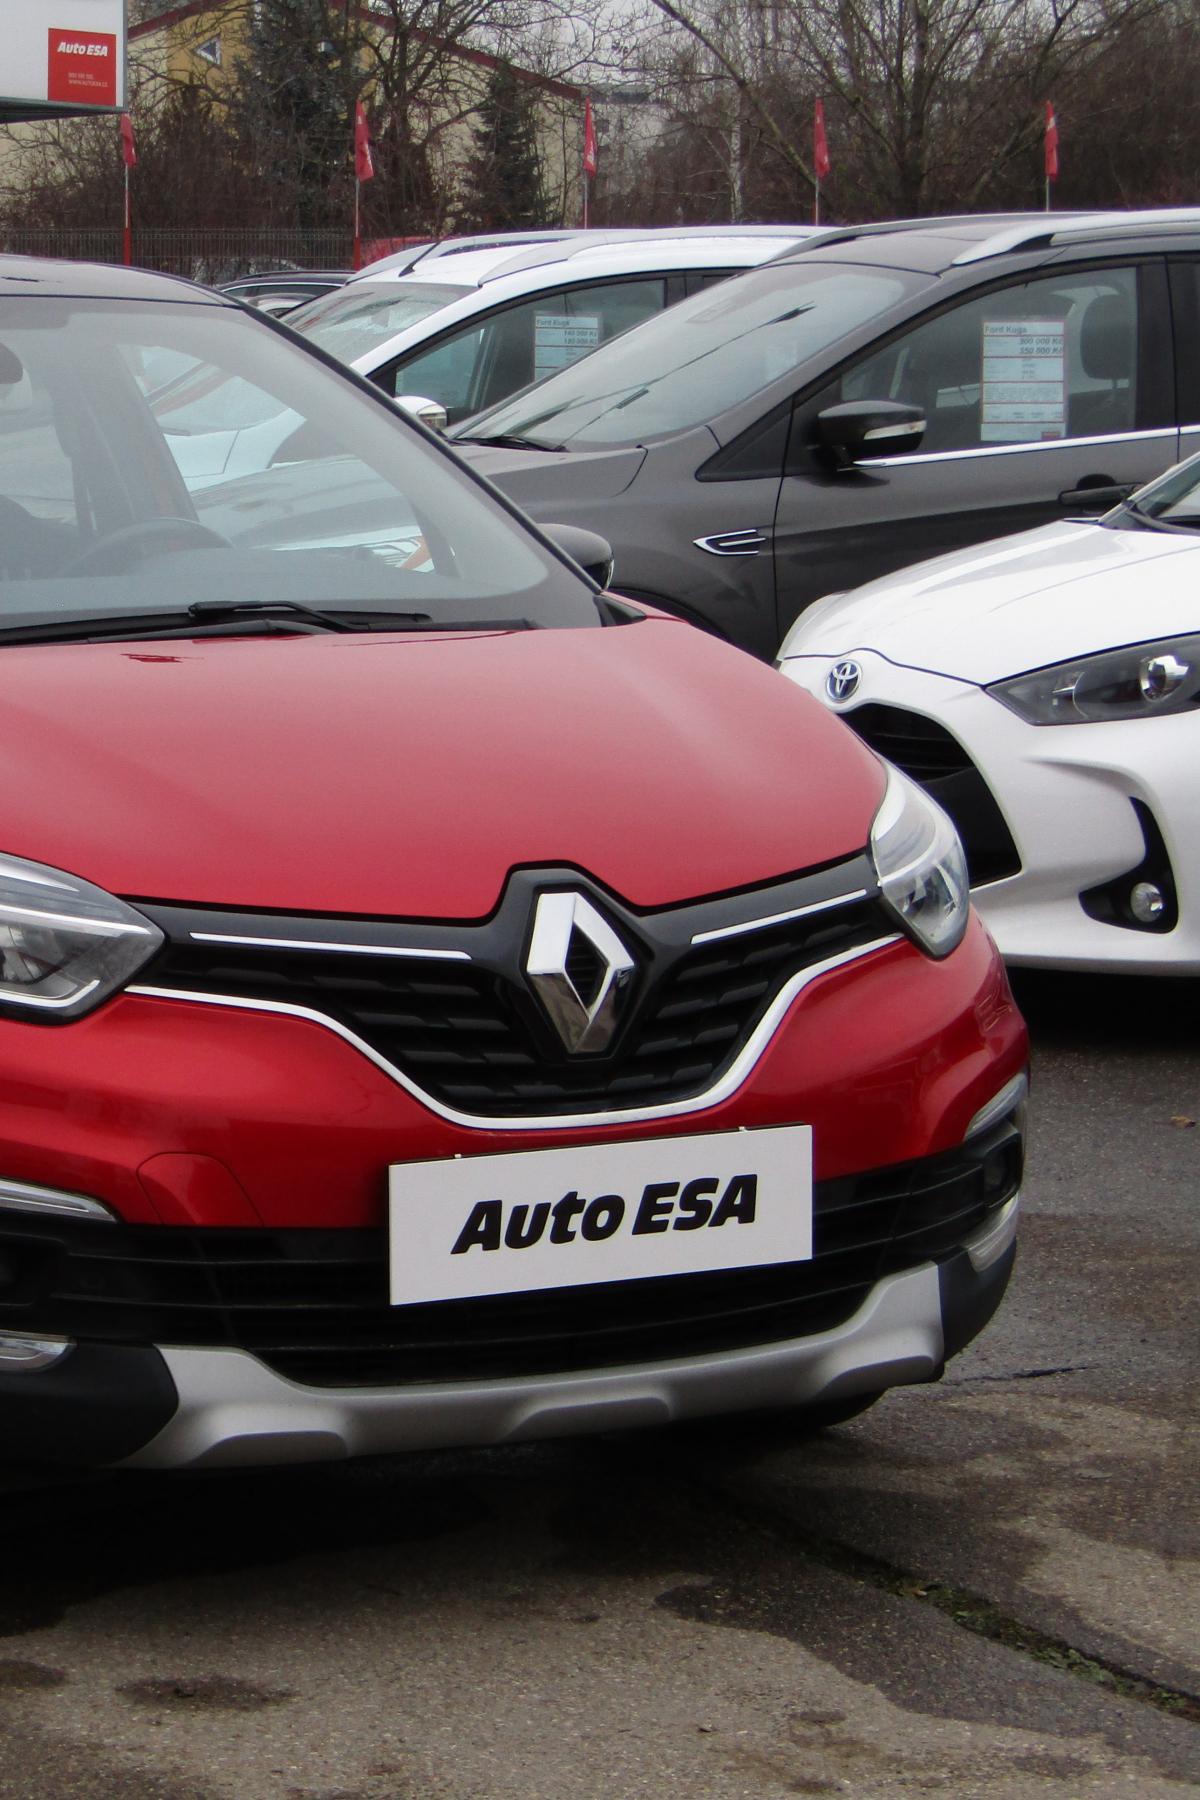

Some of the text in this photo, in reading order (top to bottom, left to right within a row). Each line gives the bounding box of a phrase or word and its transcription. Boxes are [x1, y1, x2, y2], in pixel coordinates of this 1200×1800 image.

[57, 41, 108, 57] Auto ESA
[450, 1173, 759, 1255] Auto ESA
